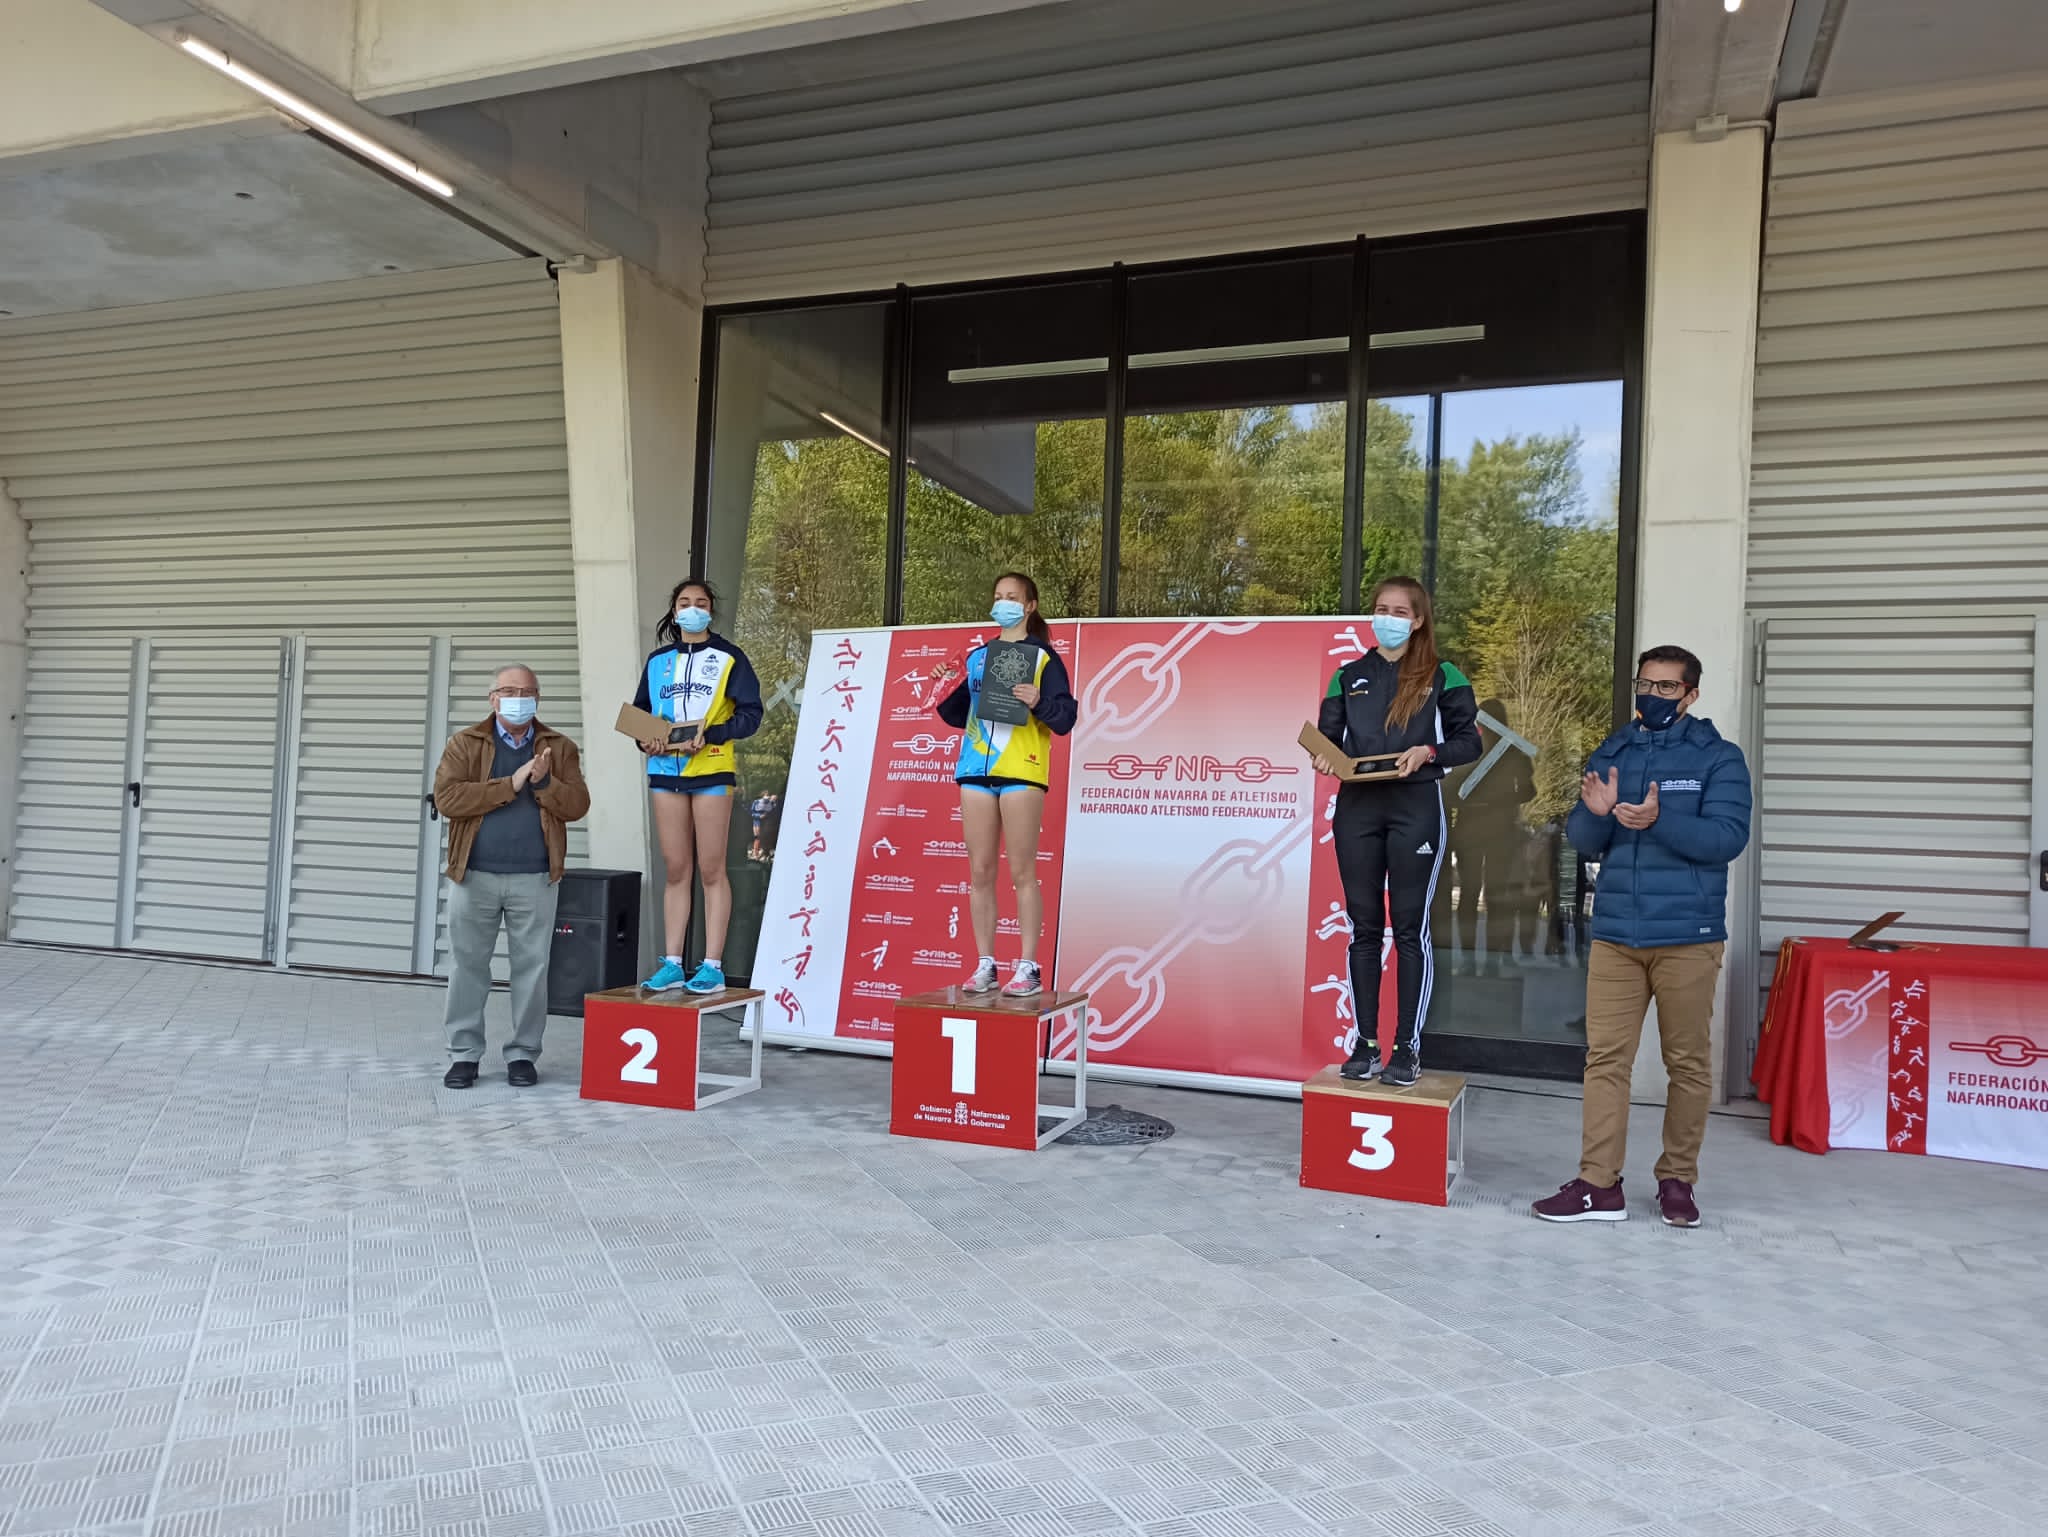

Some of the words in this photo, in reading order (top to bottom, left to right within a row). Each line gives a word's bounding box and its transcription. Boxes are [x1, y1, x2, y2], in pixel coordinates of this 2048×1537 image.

[660, 682, 713, 699] Quesrem
[889, 759, 940, 770] FEDERACIÓN
[887, 772, 939, 783] NAFARROAKO
[1081, 786, 1150, 800] FEDERACIÓN
[1154, 789, 1208, 801] NAVARRA
[1212, 790, 1226, 801] DE
[1230, 791, 1297, 803] ATLETISMO
[1080, 803, 1148, 816] NAFARROAKO
[1150, 804, 1209, 817] ATLETISMO
[1212, 806, 1297, 819] FEDERAKUNTZA
[619, 1028, 659, 1085] 2
[941, 1017, 977, 1095] 1
[920, 1104, 952, 1115] Gobierno
[1947, 1090, 2048, 1112] NAFARROAKO
[914, 1111, 923, 1120] de
[924, 1113, 952, 1124] Navarra
[1347, 1112, 1396, 1171] 3
